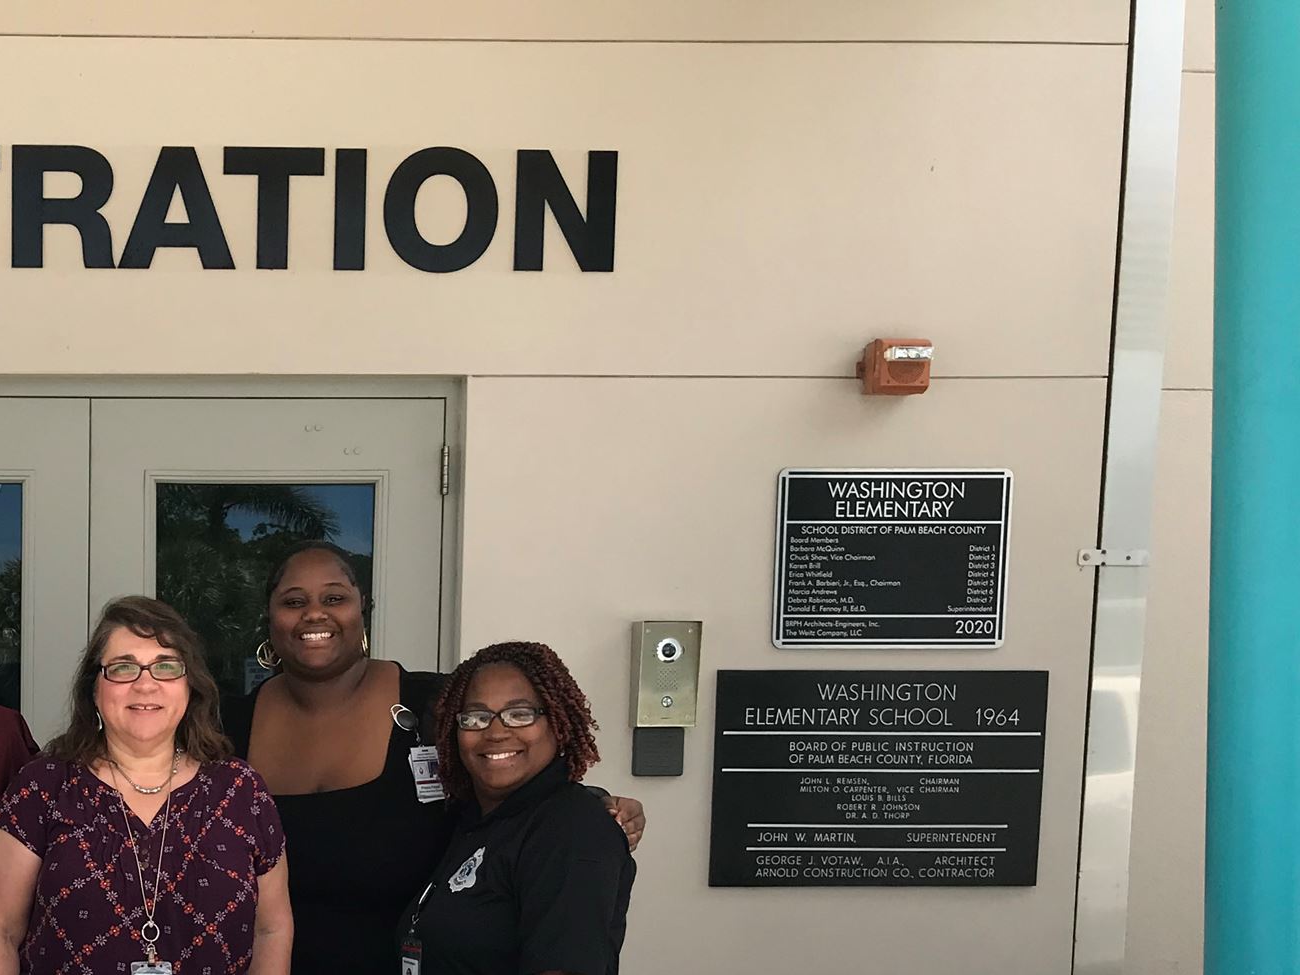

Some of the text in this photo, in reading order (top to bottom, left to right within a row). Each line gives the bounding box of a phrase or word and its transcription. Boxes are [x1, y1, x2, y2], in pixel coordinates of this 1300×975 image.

[828, 481, 966, 499] WASHINGTON
[835, 501, 955, 518] ELEMENTARY
[801, 526, 986, 535] SCHOOL DISTRICT OF PALM BEACH COUNTY
[955, 620, 994, 634] 2020
[817, 684, 957, 701] WASHINGTON
[745, 707, 1020, 726] ELEMENTARY SCHOOL 1964
[789, 741, 974, 752] BOARD OF PUBLIC INSTRUCTION
[789, 754, 805, 764] OF
[808, 754, 835, 764] PALM
[838, 754, 872, 764] BEACH
[928, 754, 973, 765] FLORIDA
[800, 777, 821, 785] JOHN
[757, 833, 856, 843] JOHN W. MARTIN,
[906, 833, 996, 843] SUPERINTENDENT
[756, 856, 802, 865] GEORGE
[934, 856, 996, 866] ARCHITECT
[756, 868, 994, 878] ARNOLD CONSTRUCTION CONTRACTOR
